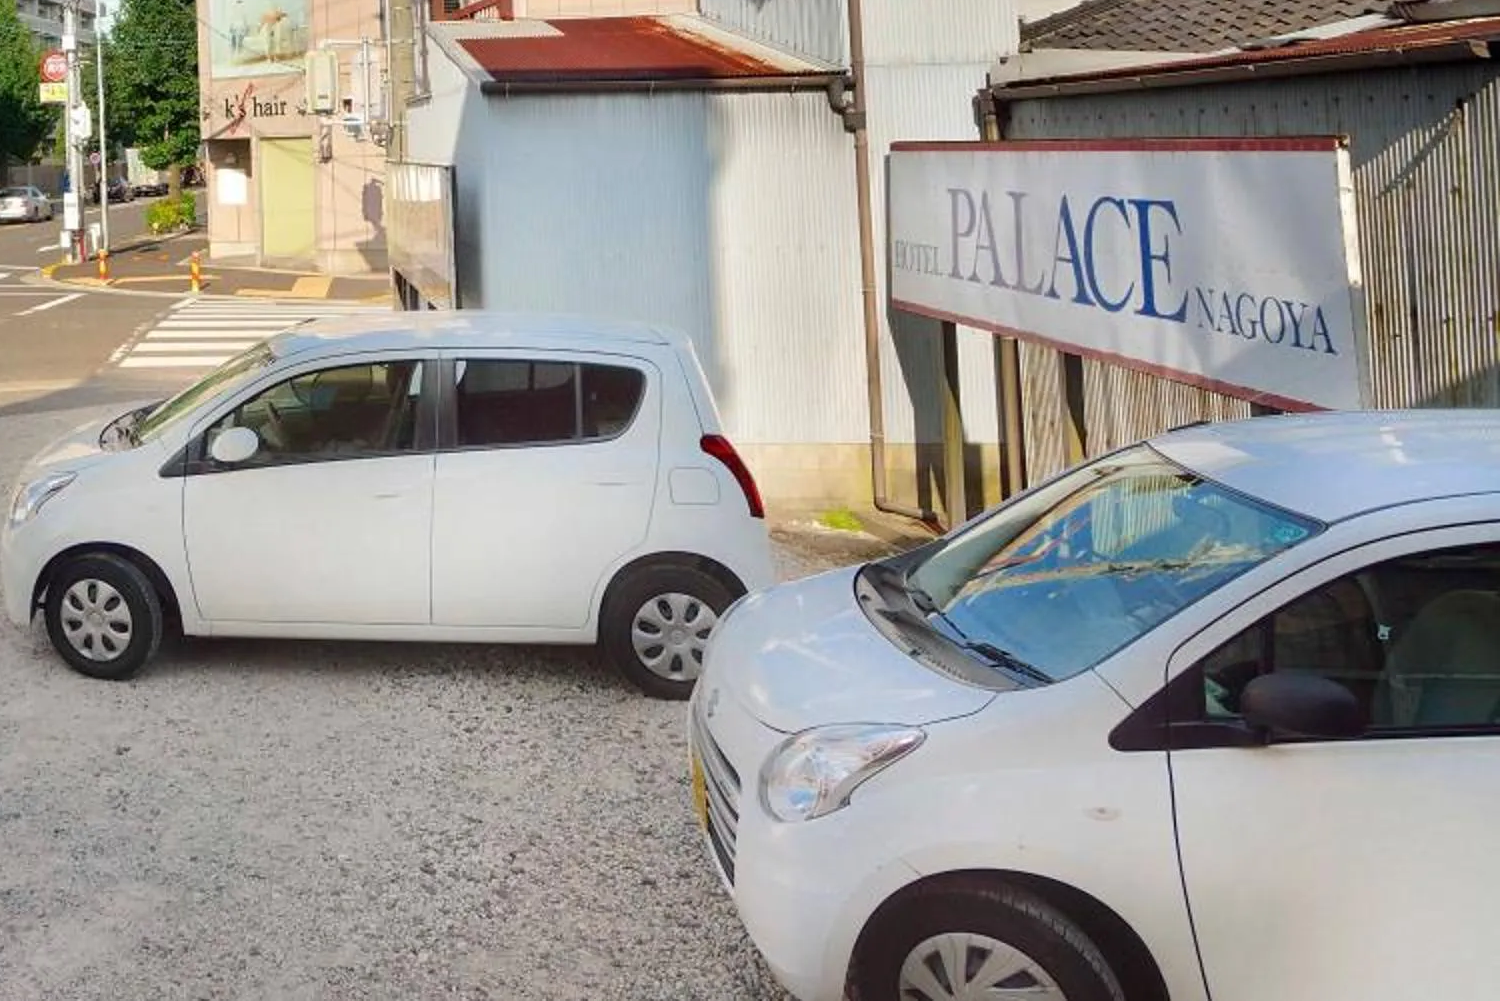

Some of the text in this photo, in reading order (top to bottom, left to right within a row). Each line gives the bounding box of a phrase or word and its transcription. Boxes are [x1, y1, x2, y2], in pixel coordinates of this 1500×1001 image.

[251, 95, 287, 117] hair
[894, 187, 1338, 355] HOTEL PALACE NAGOYA
